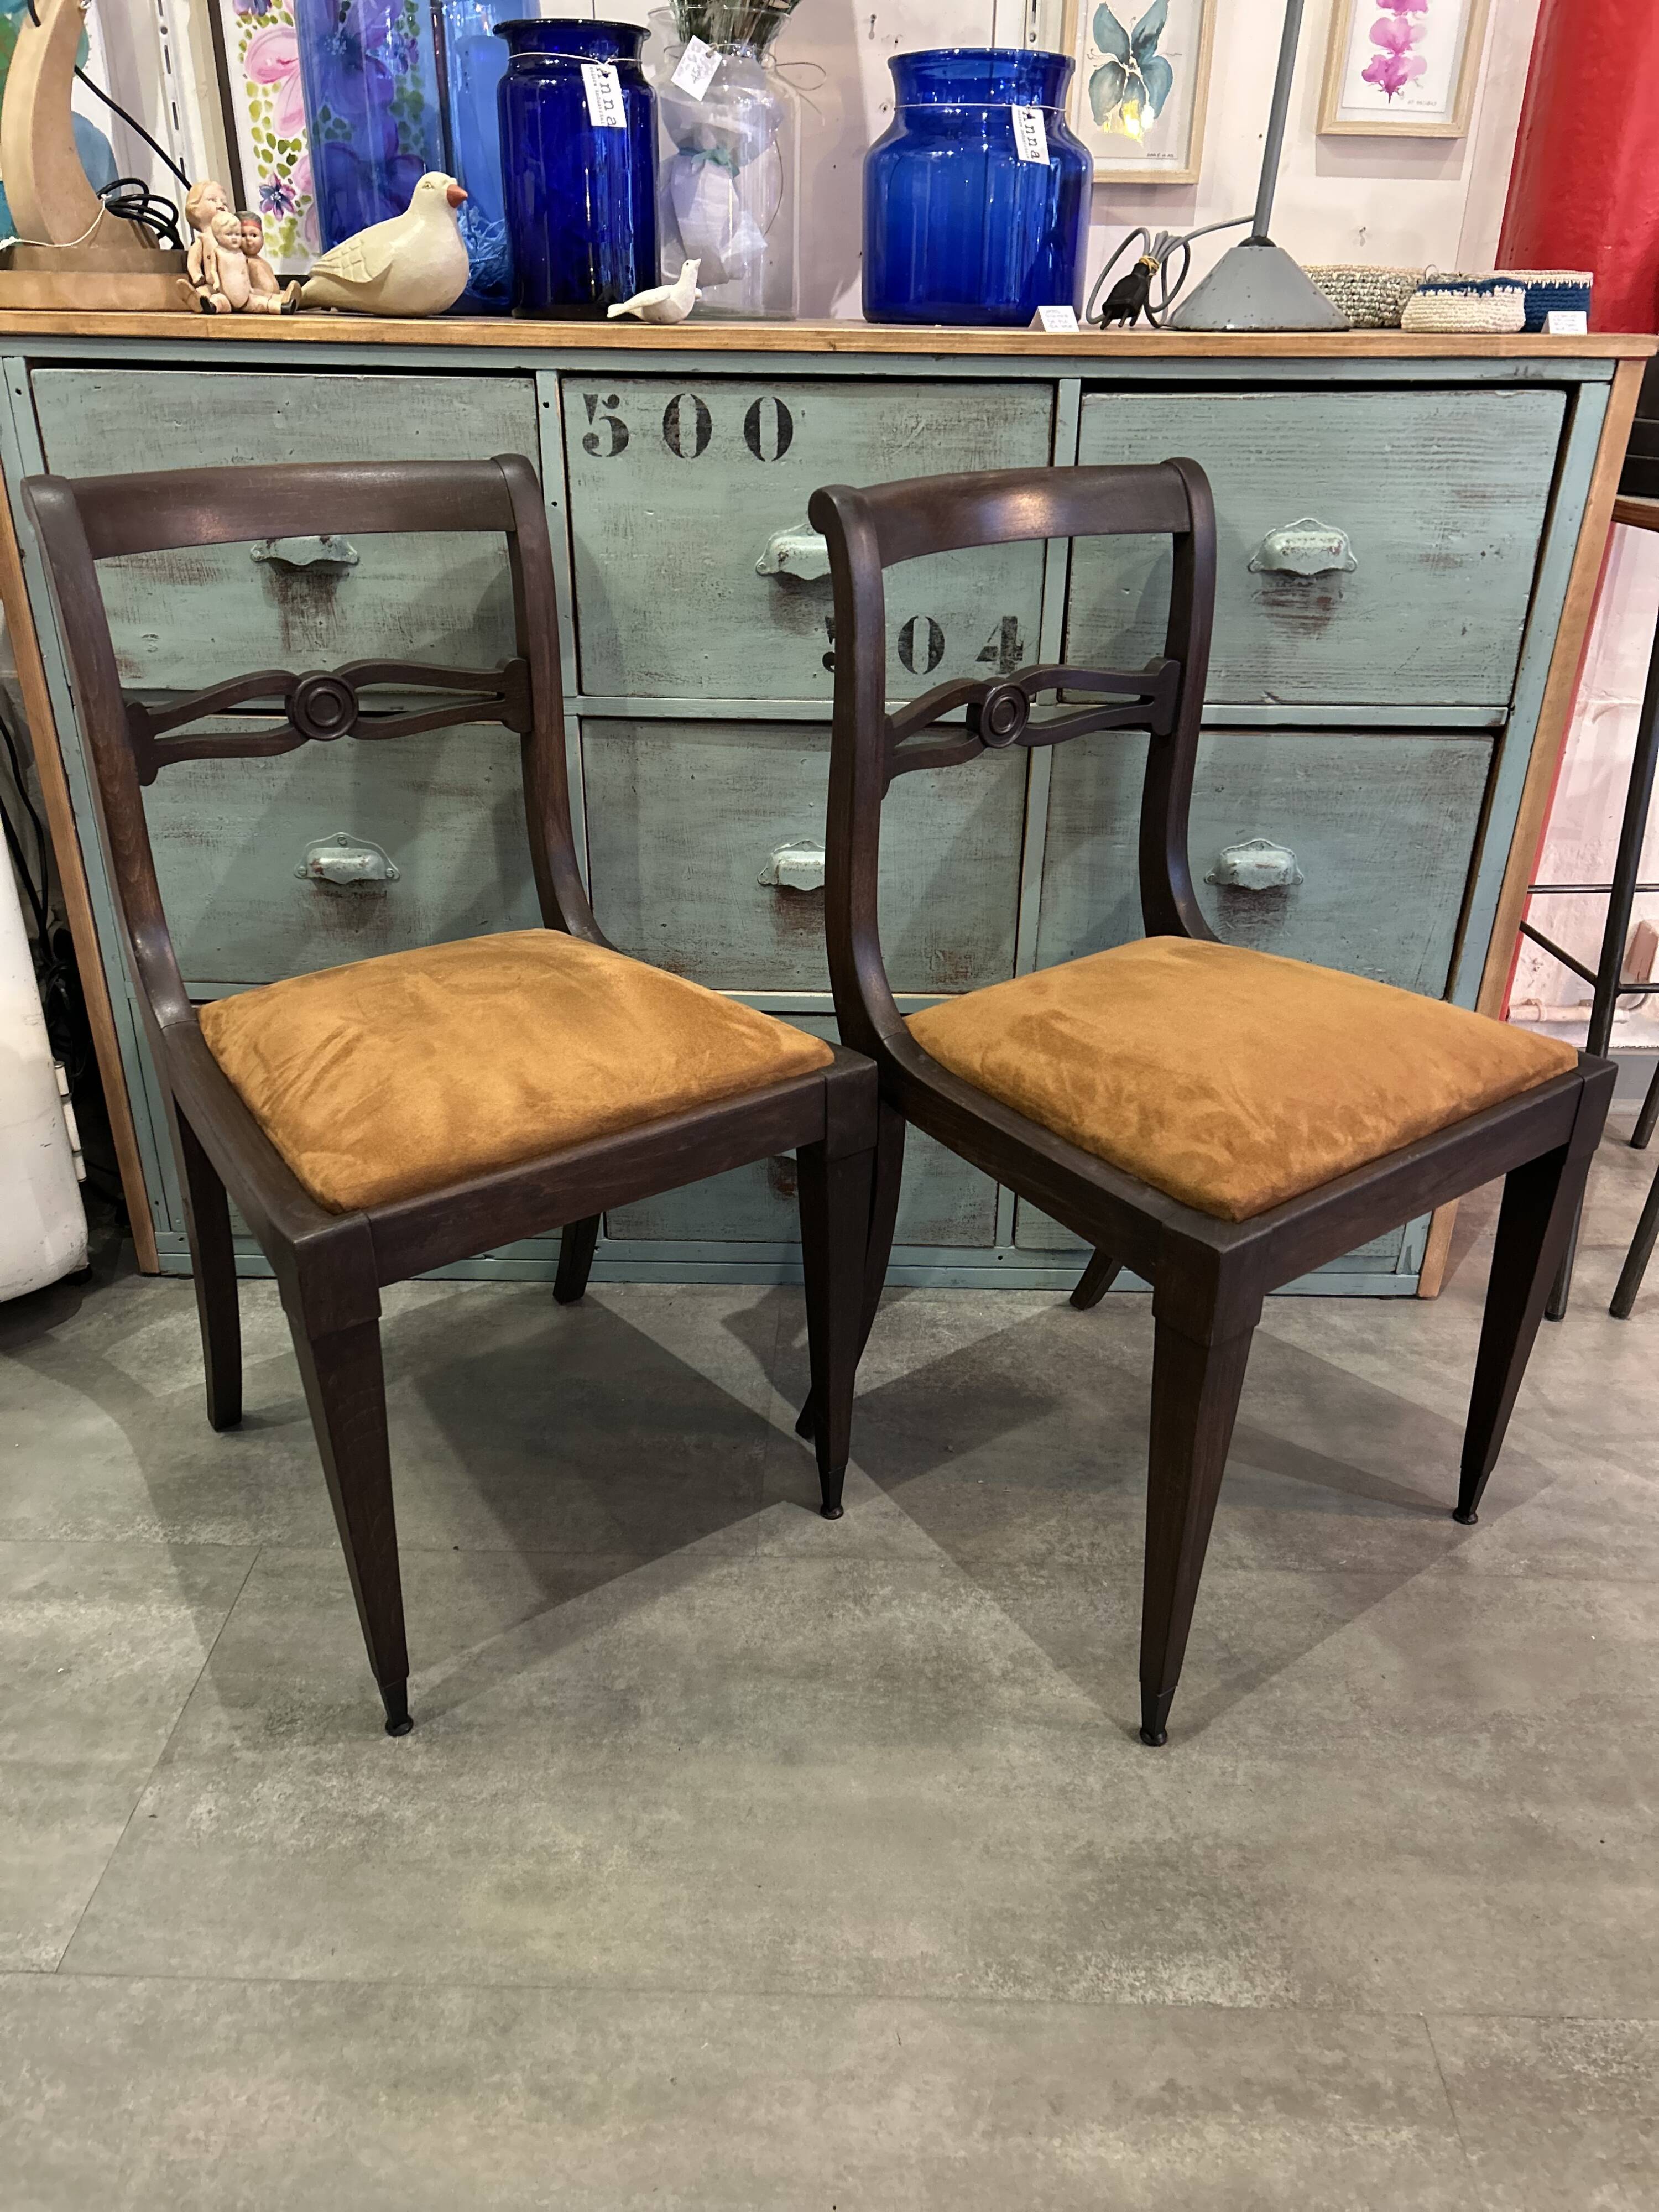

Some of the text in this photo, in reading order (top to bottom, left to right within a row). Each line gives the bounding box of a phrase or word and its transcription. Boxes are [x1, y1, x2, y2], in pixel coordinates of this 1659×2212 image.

[1022, 111, 1040, 159] Anna
[582, 393, 794, 462] 500
[822, 615, 1023, 674] 04
